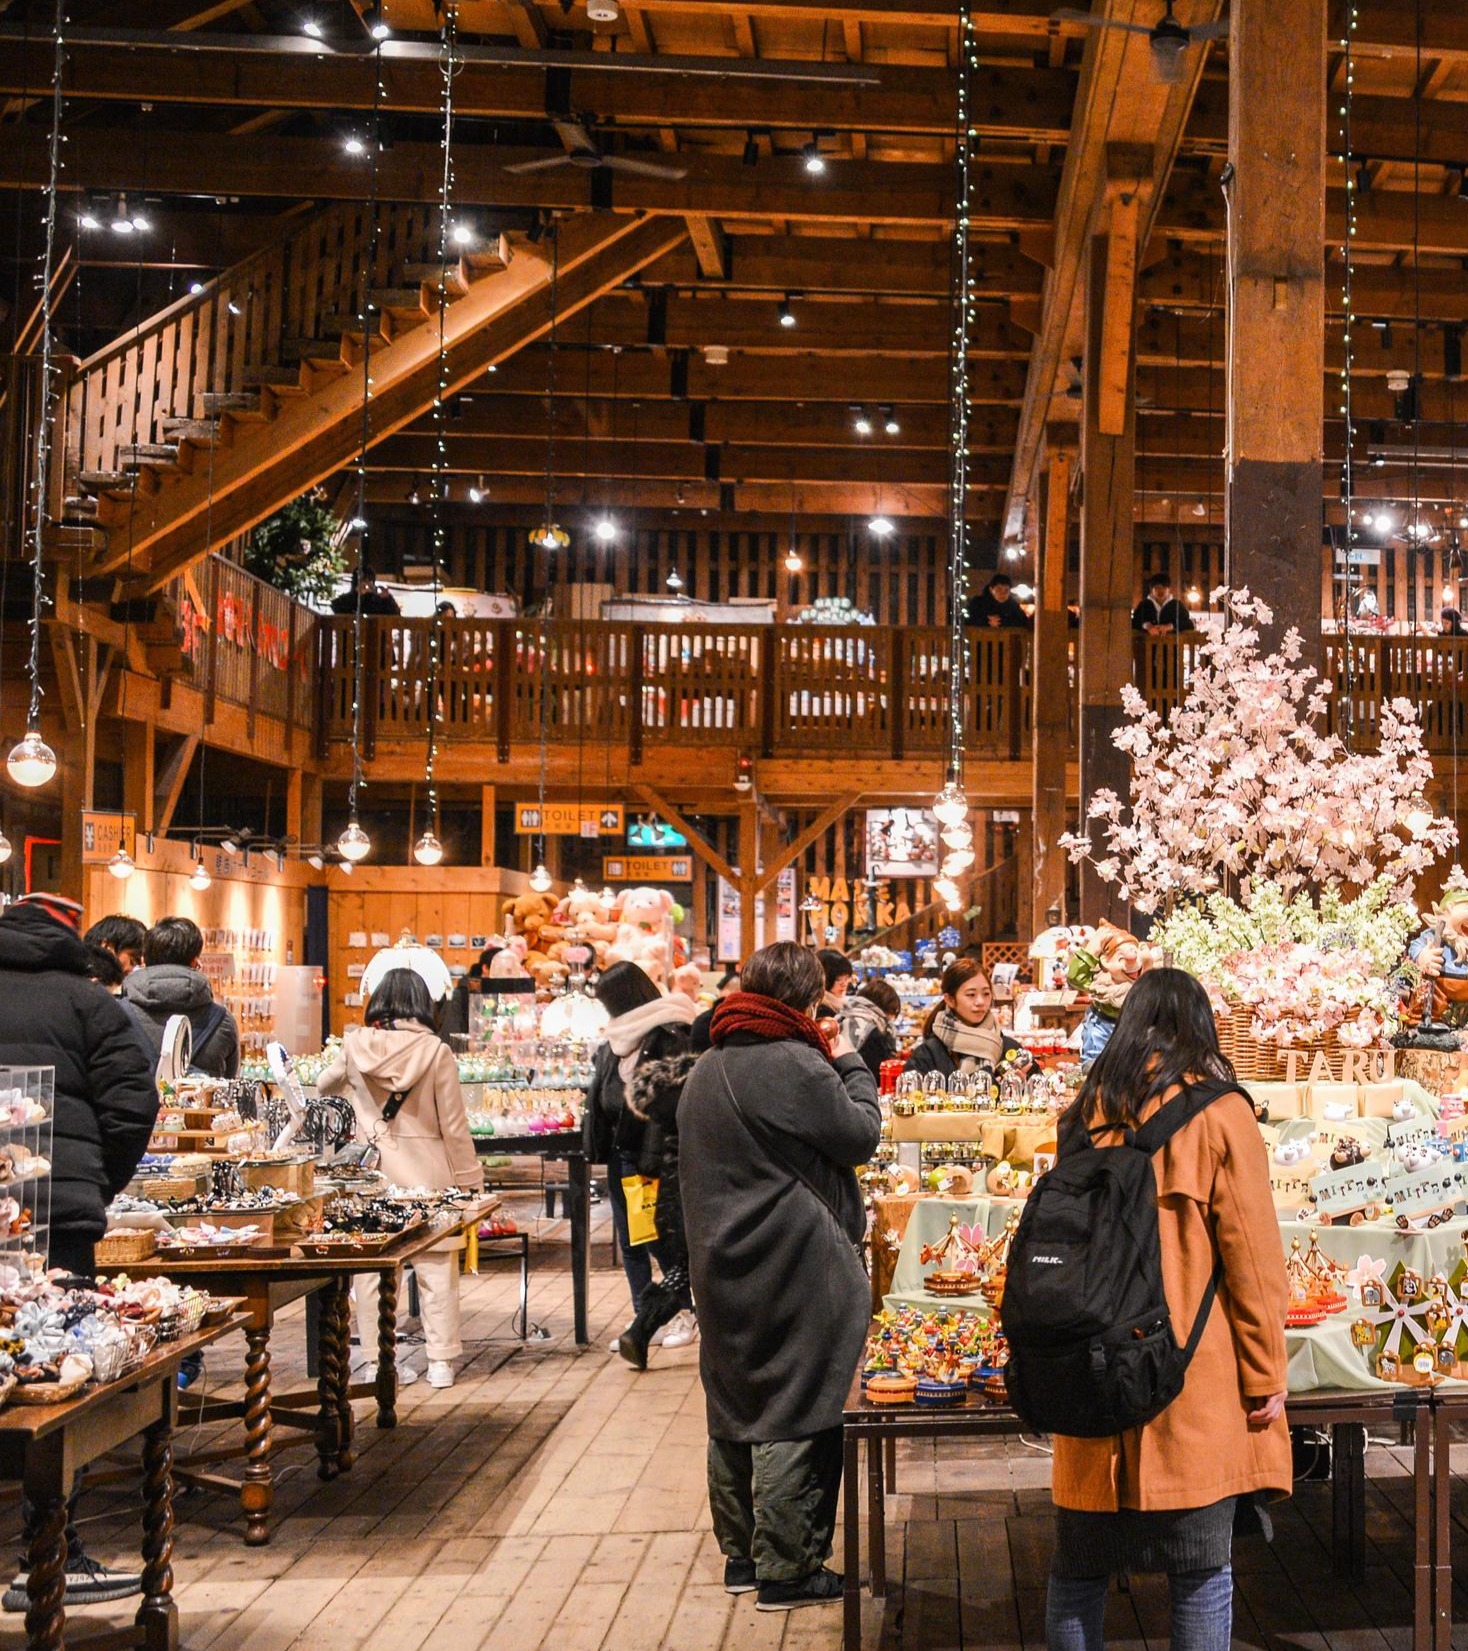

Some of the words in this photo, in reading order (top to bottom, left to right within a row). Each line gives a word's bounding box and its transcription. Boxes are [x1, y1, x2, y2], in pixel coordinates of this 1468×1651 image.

[544, 809, 596, 821] TOILET
[626, 861, 669, 871] TOILET
[1276, 1049, 1398, 1086] TARU
